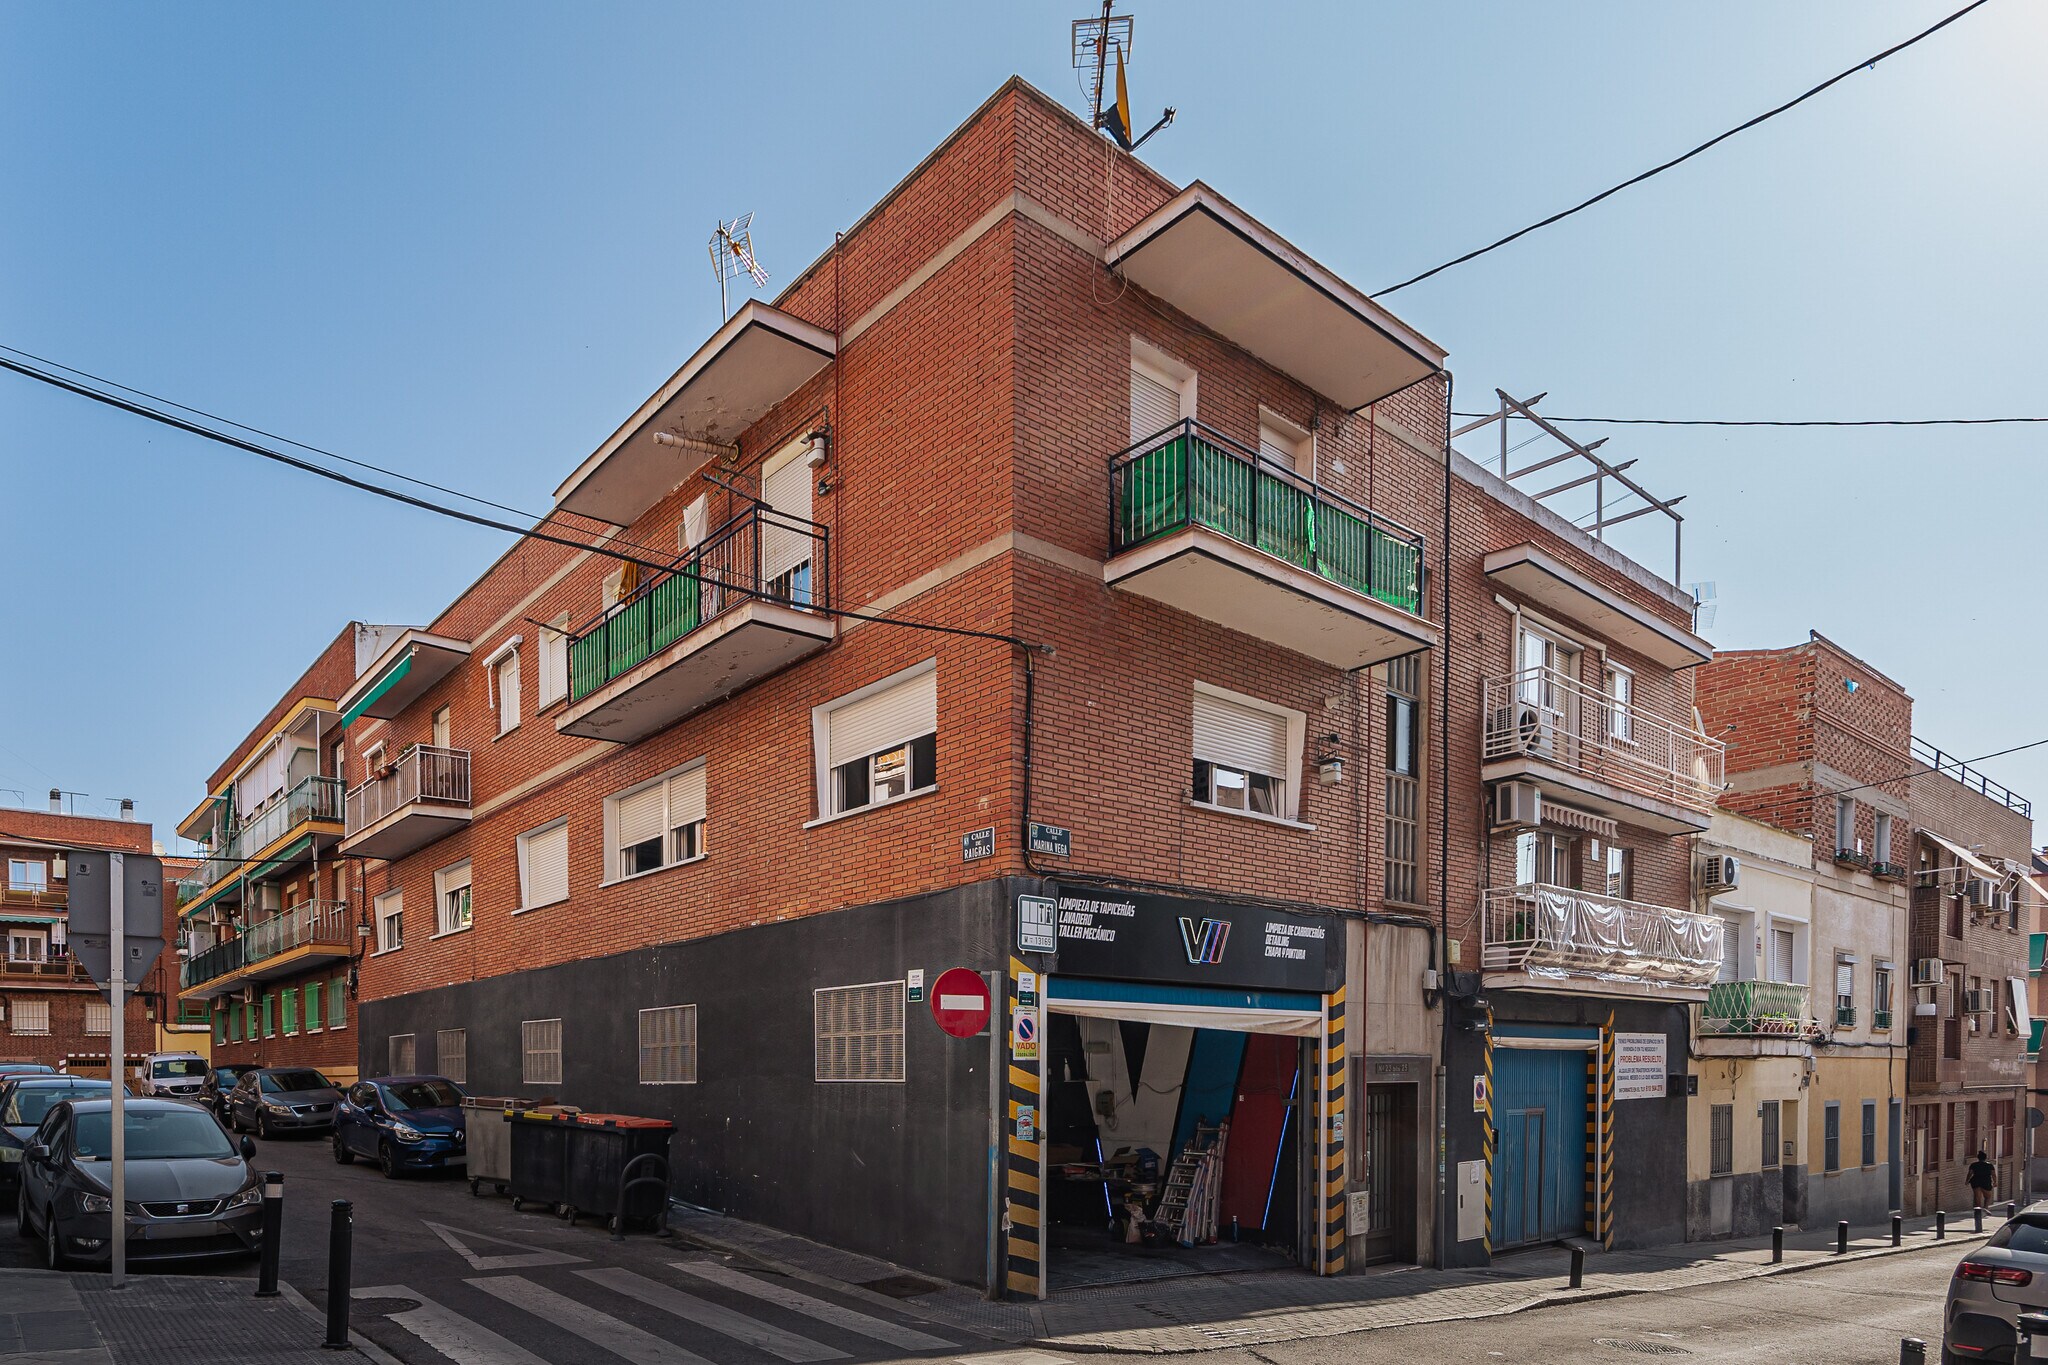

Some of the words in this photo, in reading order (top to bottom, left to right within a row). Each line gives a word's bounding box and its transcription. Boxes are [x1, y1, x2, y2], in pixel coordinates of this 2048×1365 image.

[971, 830, 990, 841] CALLE
[1045, 827, 1063, 836] CALLE
[964, 844, 991, 860] RAIGRAS
[1033, 838, 1054, 852] MARINA
[1054, 842, 1068, 855] VEGA
[1058, 897, 1090, 912] LIMPIEZA
[1090, 901, 1099, 913] DE
[1099, 901, 1136, 917] TAPICERÍAS
[1058, 911, 1093, 926] LAVADERO
[1058, 925, 1083, 938] TALLER
[1083, 925, 1116, 942] MECÁNICO
[1265, 922, 1287, 935] LIMPIEZA
[1287, 925, 1294, 936] DE
[1294, 925, 1325, 939] CARROCERÍAS
[1265, 934, 1290, 947] DETAILING
[1265, 946, 1281, 957] CHAPA
[1285, 947, 1306, 960] PINTURA
[1016, 1042, 1037, 1050] VADO
